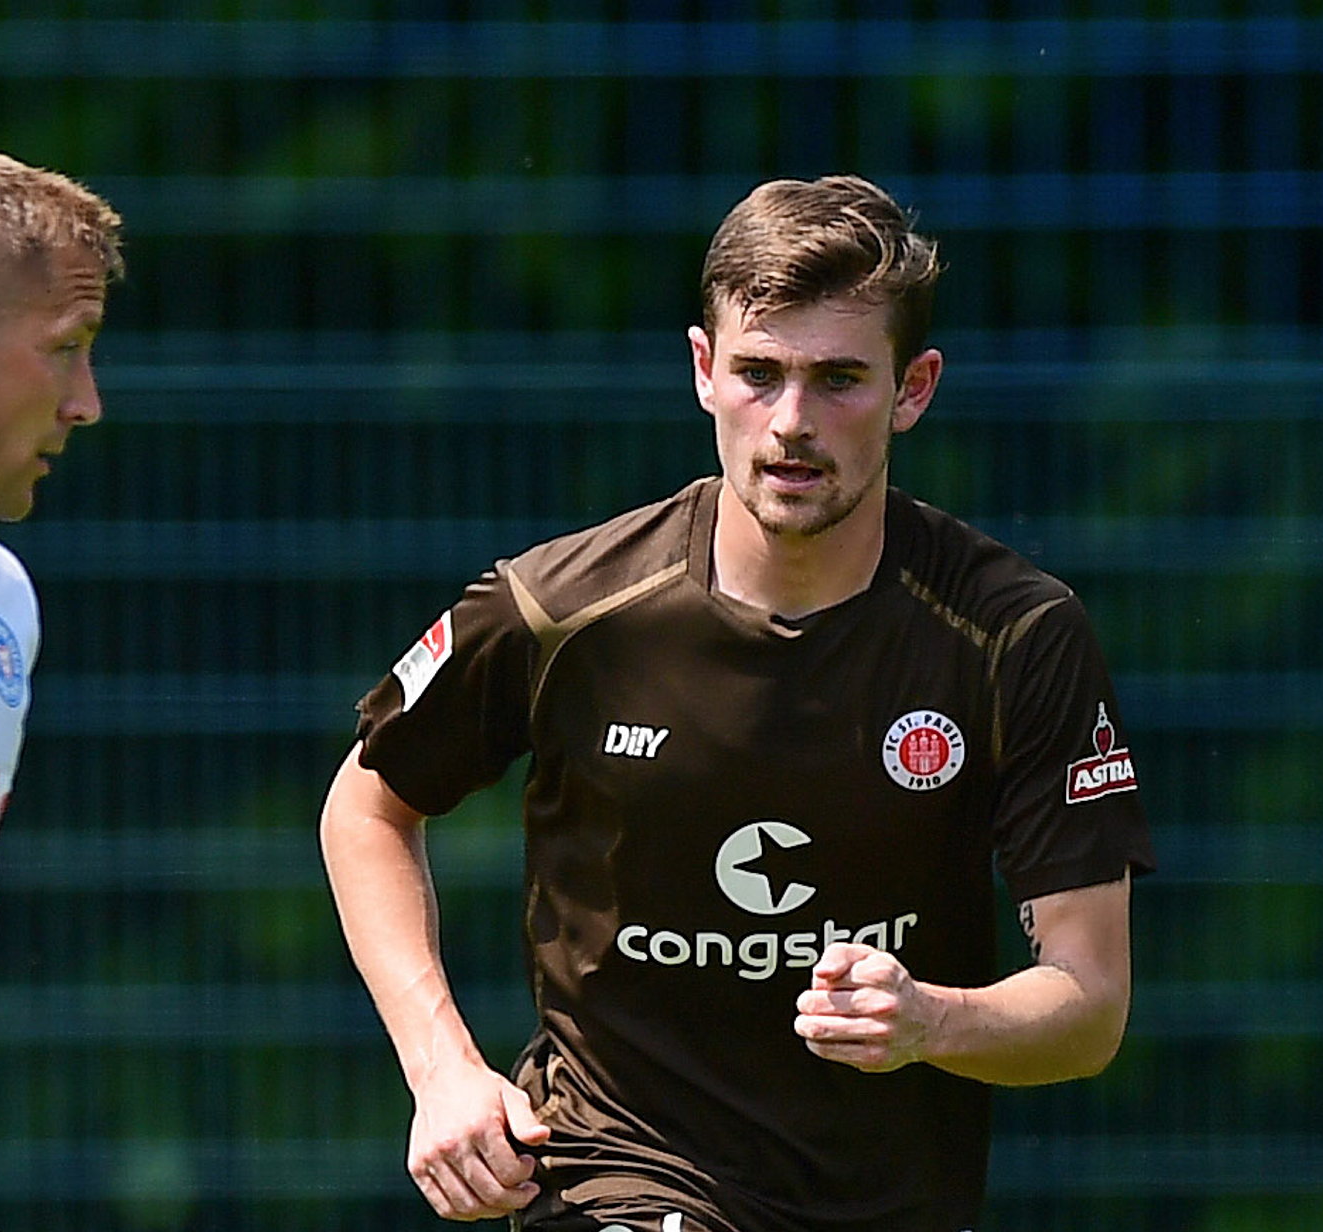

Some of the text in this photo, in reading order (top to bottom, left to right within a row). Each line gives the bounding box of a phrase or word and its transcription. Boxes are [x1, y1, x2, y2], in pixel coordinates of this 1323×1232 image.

[924, 713, 963, 749] PAULI
[908, 775, 941, 788] 1910
[1073, 758, 1136, 793] ASTRA
